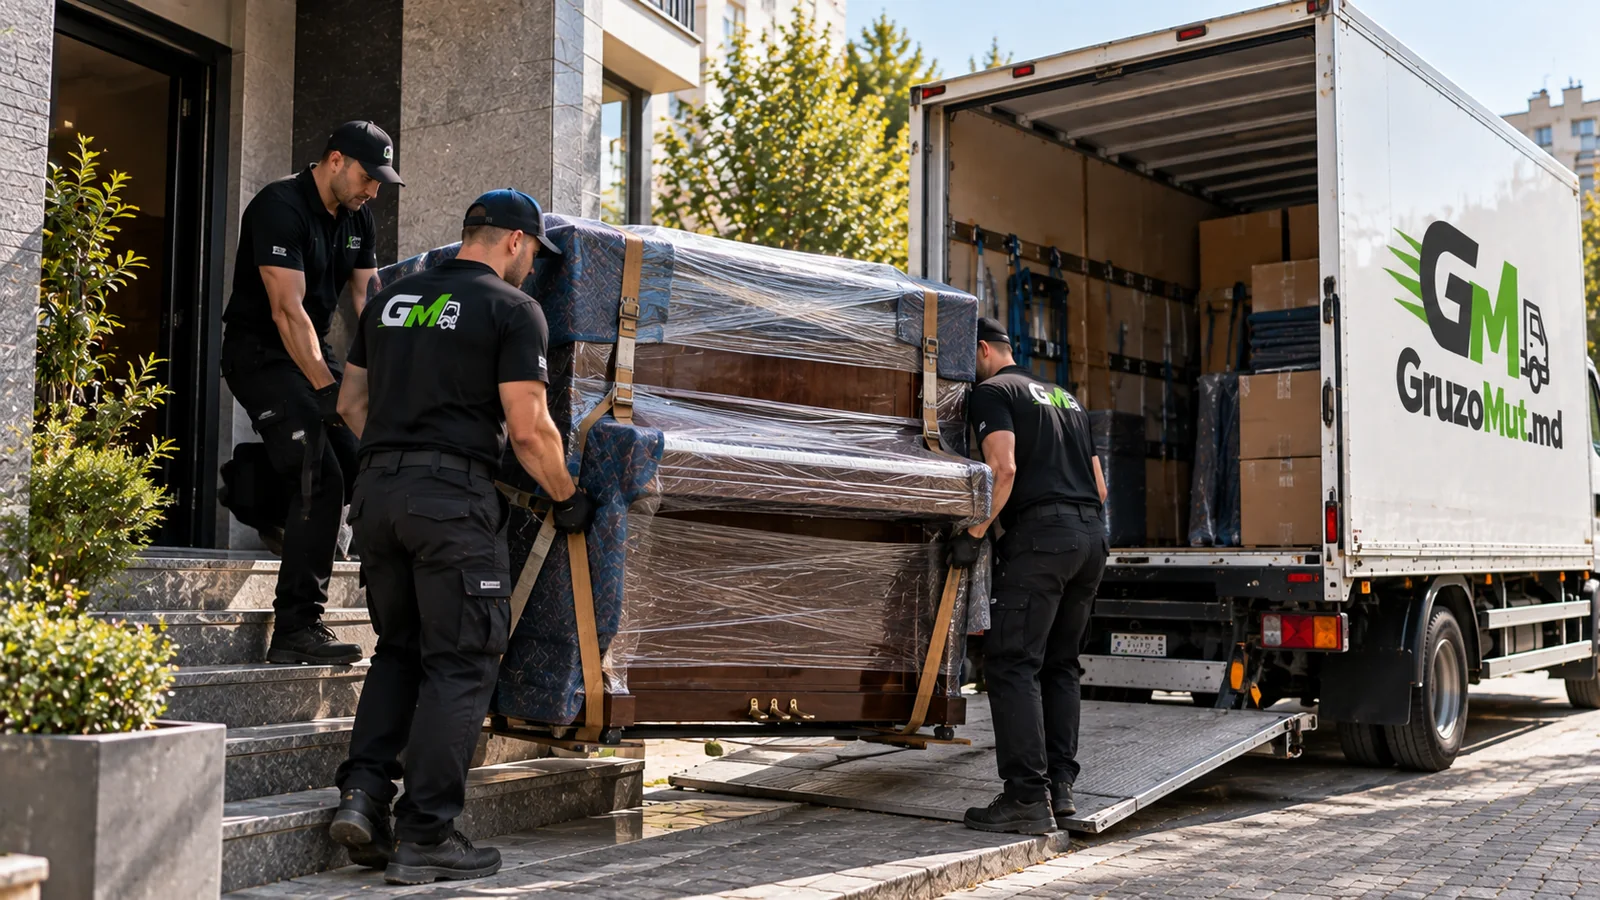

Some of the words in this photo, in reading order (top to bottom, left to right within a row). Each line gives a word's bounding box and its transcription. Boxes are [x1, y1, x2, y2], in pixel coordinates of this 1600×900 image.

[381, 293, 453, 328] GM
[1419, 220, 1520, 379] GM
[1028, 382, 1071, 409] GM
[1396, 347, 1563, 449] GruzoMut.md
